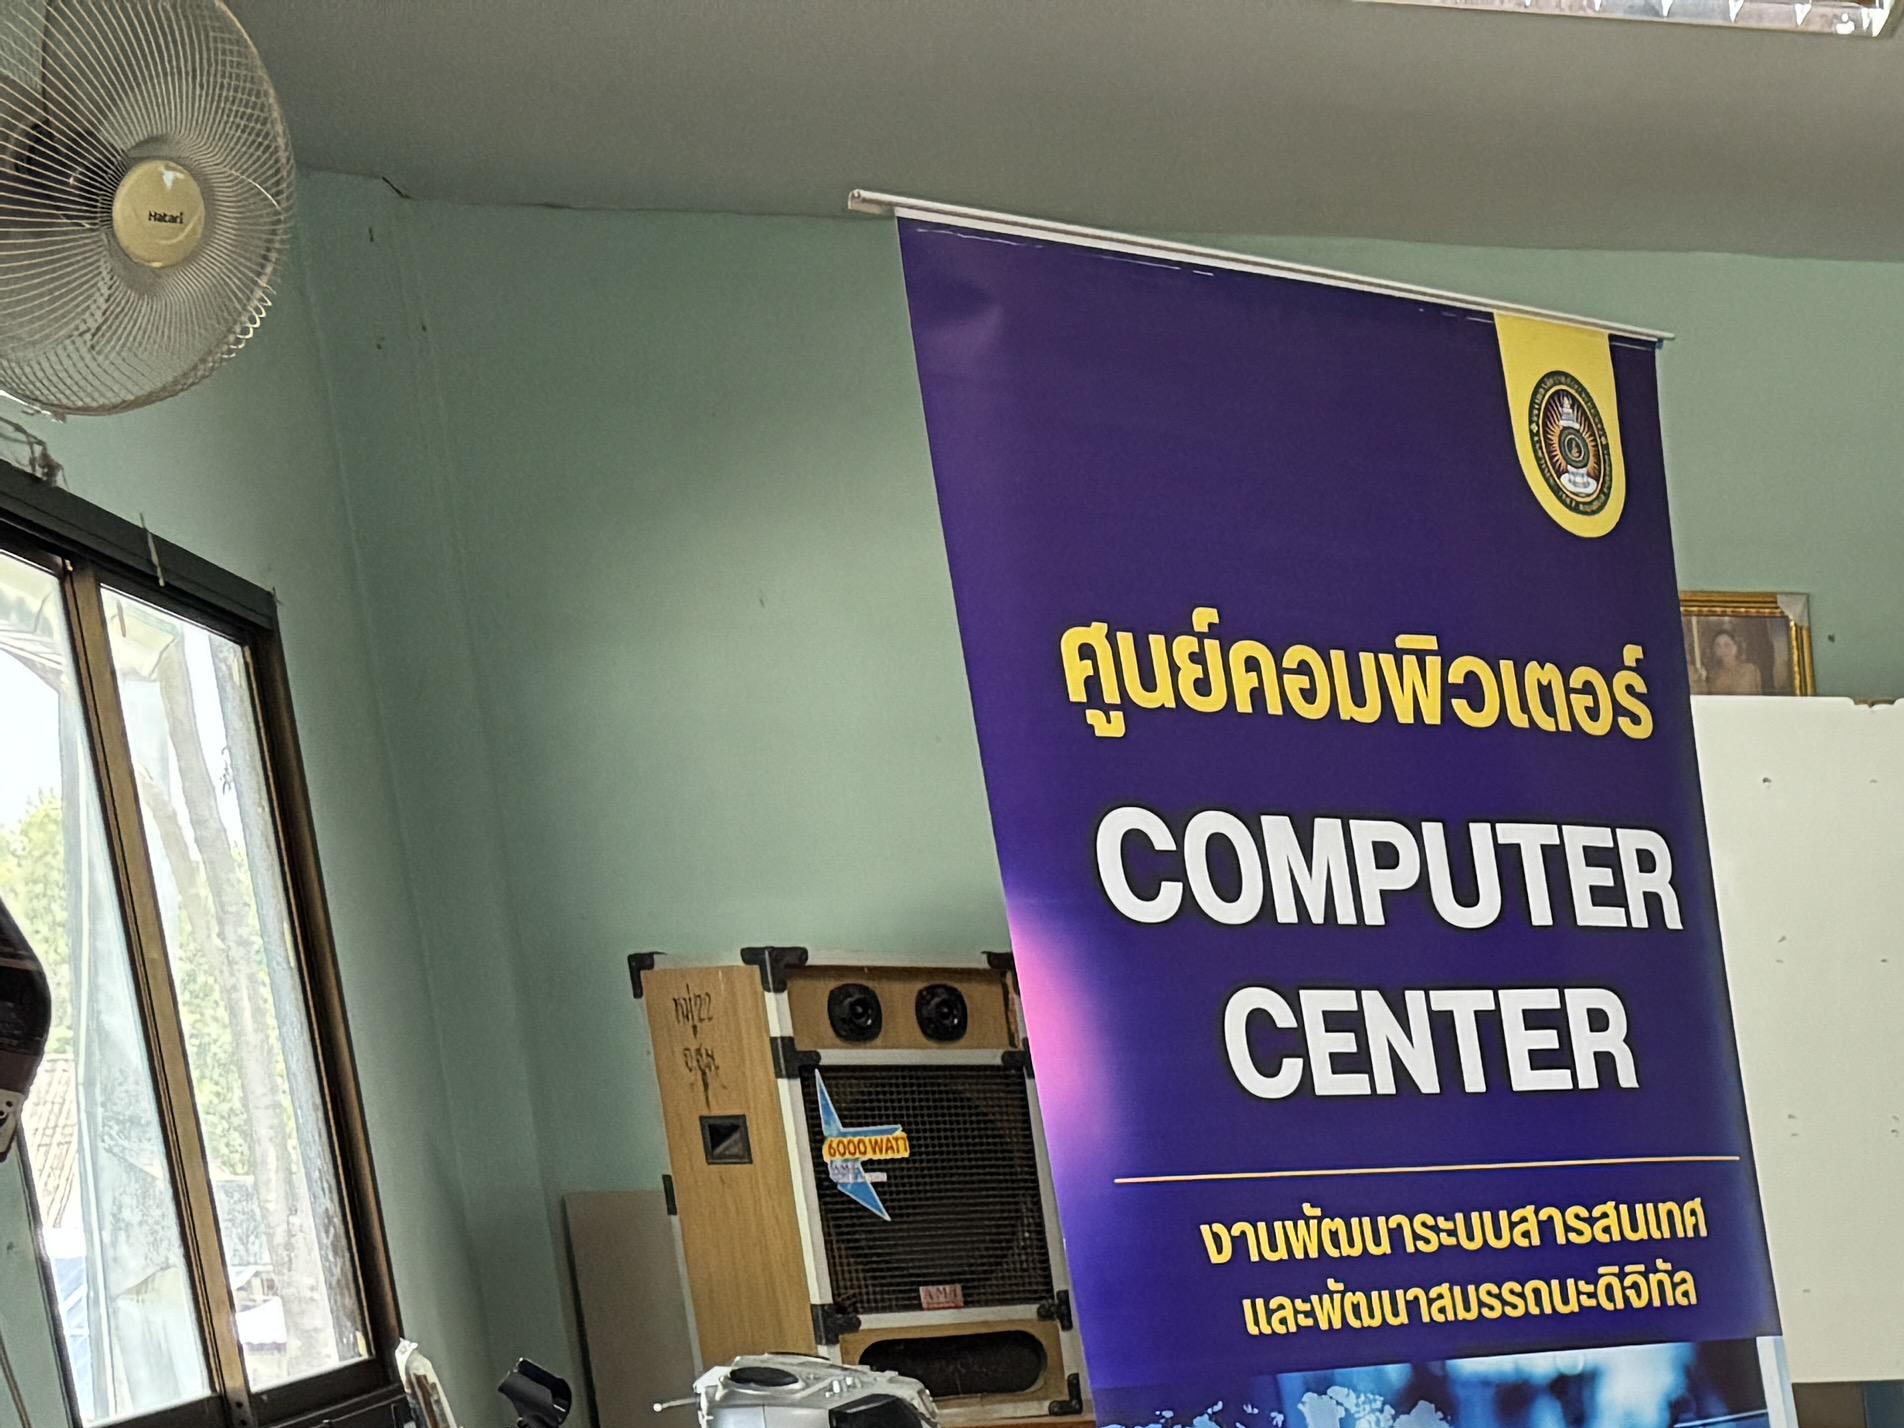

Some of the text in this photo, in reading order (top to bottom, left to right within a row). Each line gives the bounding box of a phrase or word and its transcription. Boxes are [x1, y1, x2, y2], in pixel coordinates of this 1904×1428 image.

[1059, 607, 1655, 740] ศูนย์คอมพิวเตอร์
[1094, 804, 1685, 932] COMPUTER
[1222, 985, 1640, 1099] CENTER
[827, 1139, 867, 1157] 6000
[1200, 1196, 1708, 1266] งานพัฒนาระบบสารสนเทศ
[1242, 1263, 1698, 1337] และพัฒนาสมรรถนะดิจิทัล
